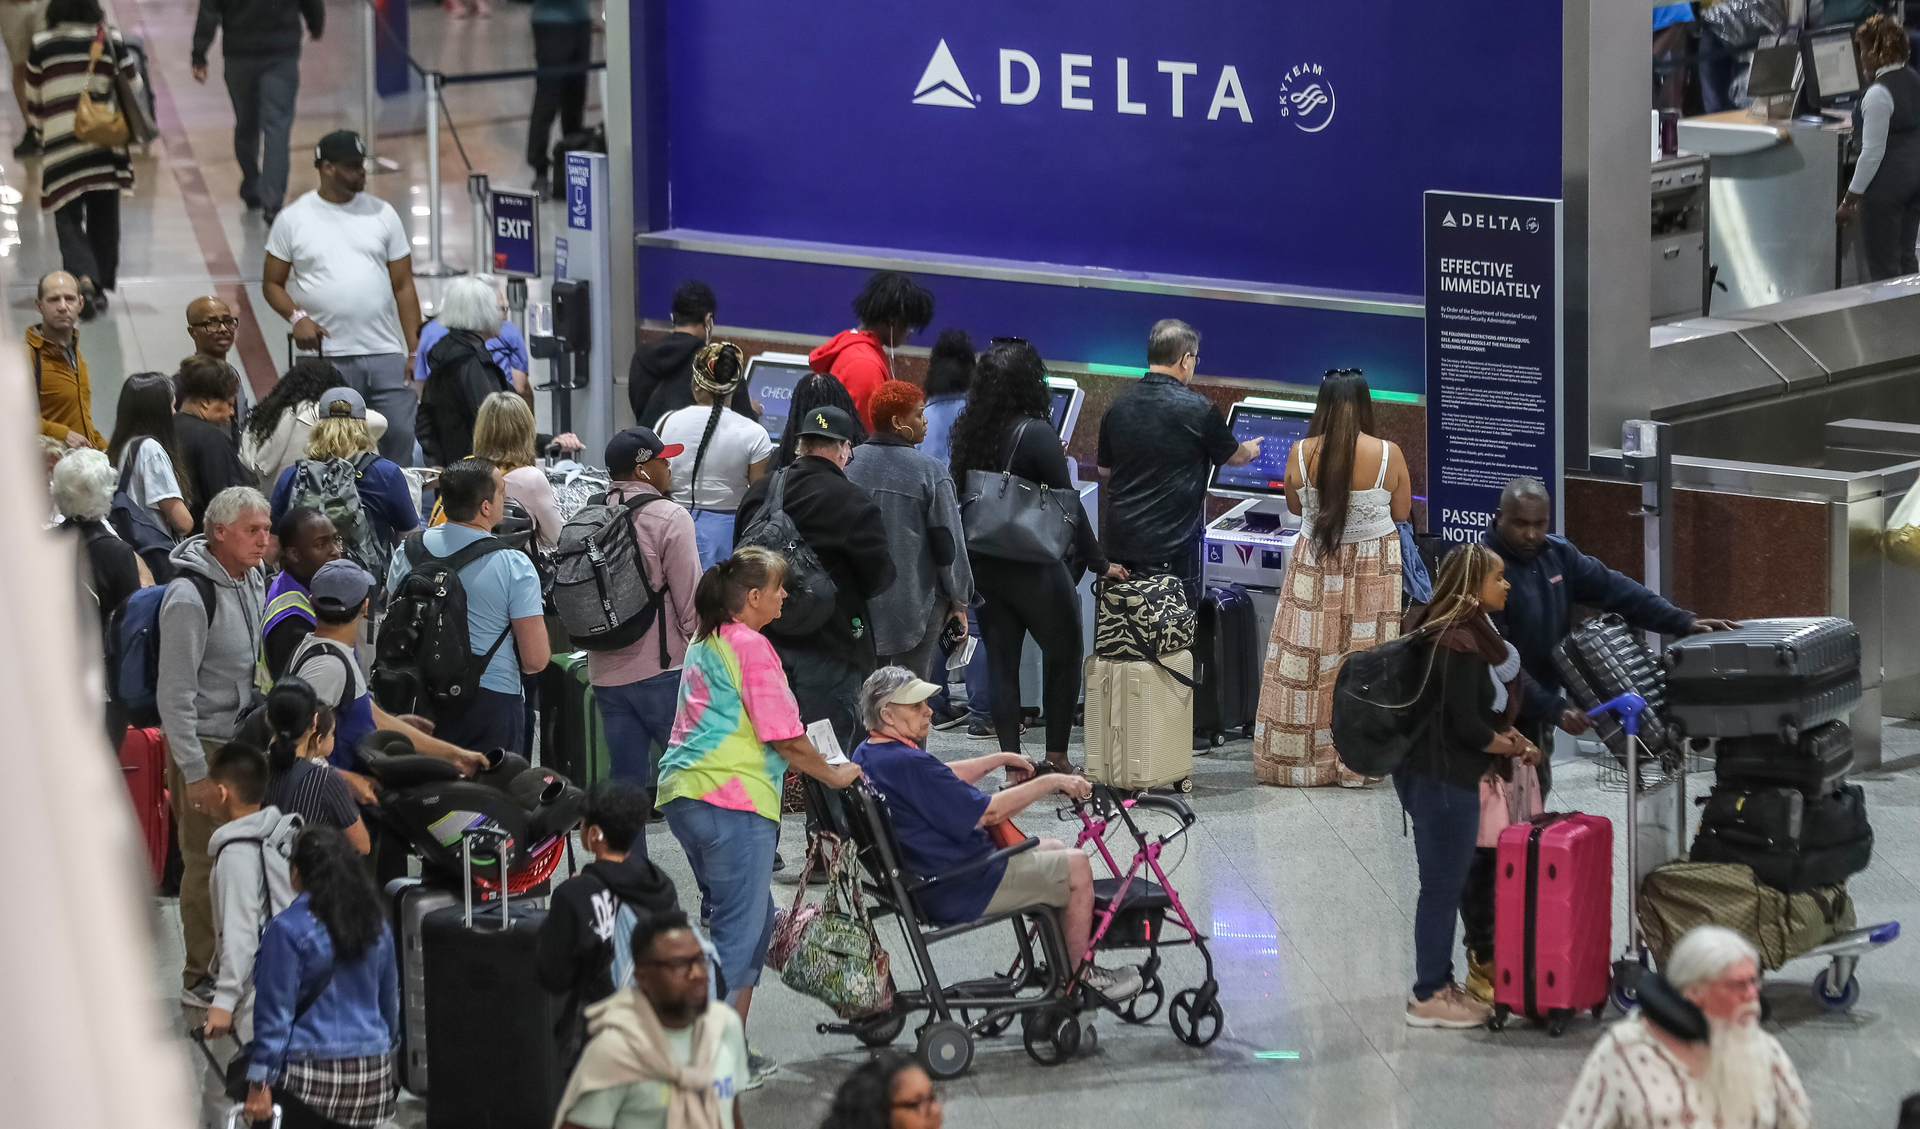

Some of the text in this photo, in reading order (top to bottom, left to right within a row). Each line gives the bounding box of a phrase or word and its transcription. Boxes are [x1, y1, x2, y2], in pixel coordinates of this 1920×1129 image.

[999, 47, 1253, 123] DELTA
[1279, 62, 1325, 117] SKYTEAM
[570, 175, 588, 187] HANDS
[497, 216, 531, 240] EXIT
[573, 215, 586, 228] HERE
[1462, 213, 1521, 231] DELTA
[1441, 258, 1513, 278] EFFECTIVE
[1441, 276, 1541, 299] IMMEDIATELY
[1441, 313, 1470, 322] Transportation
[1471, 309, 1494, 317] Department
